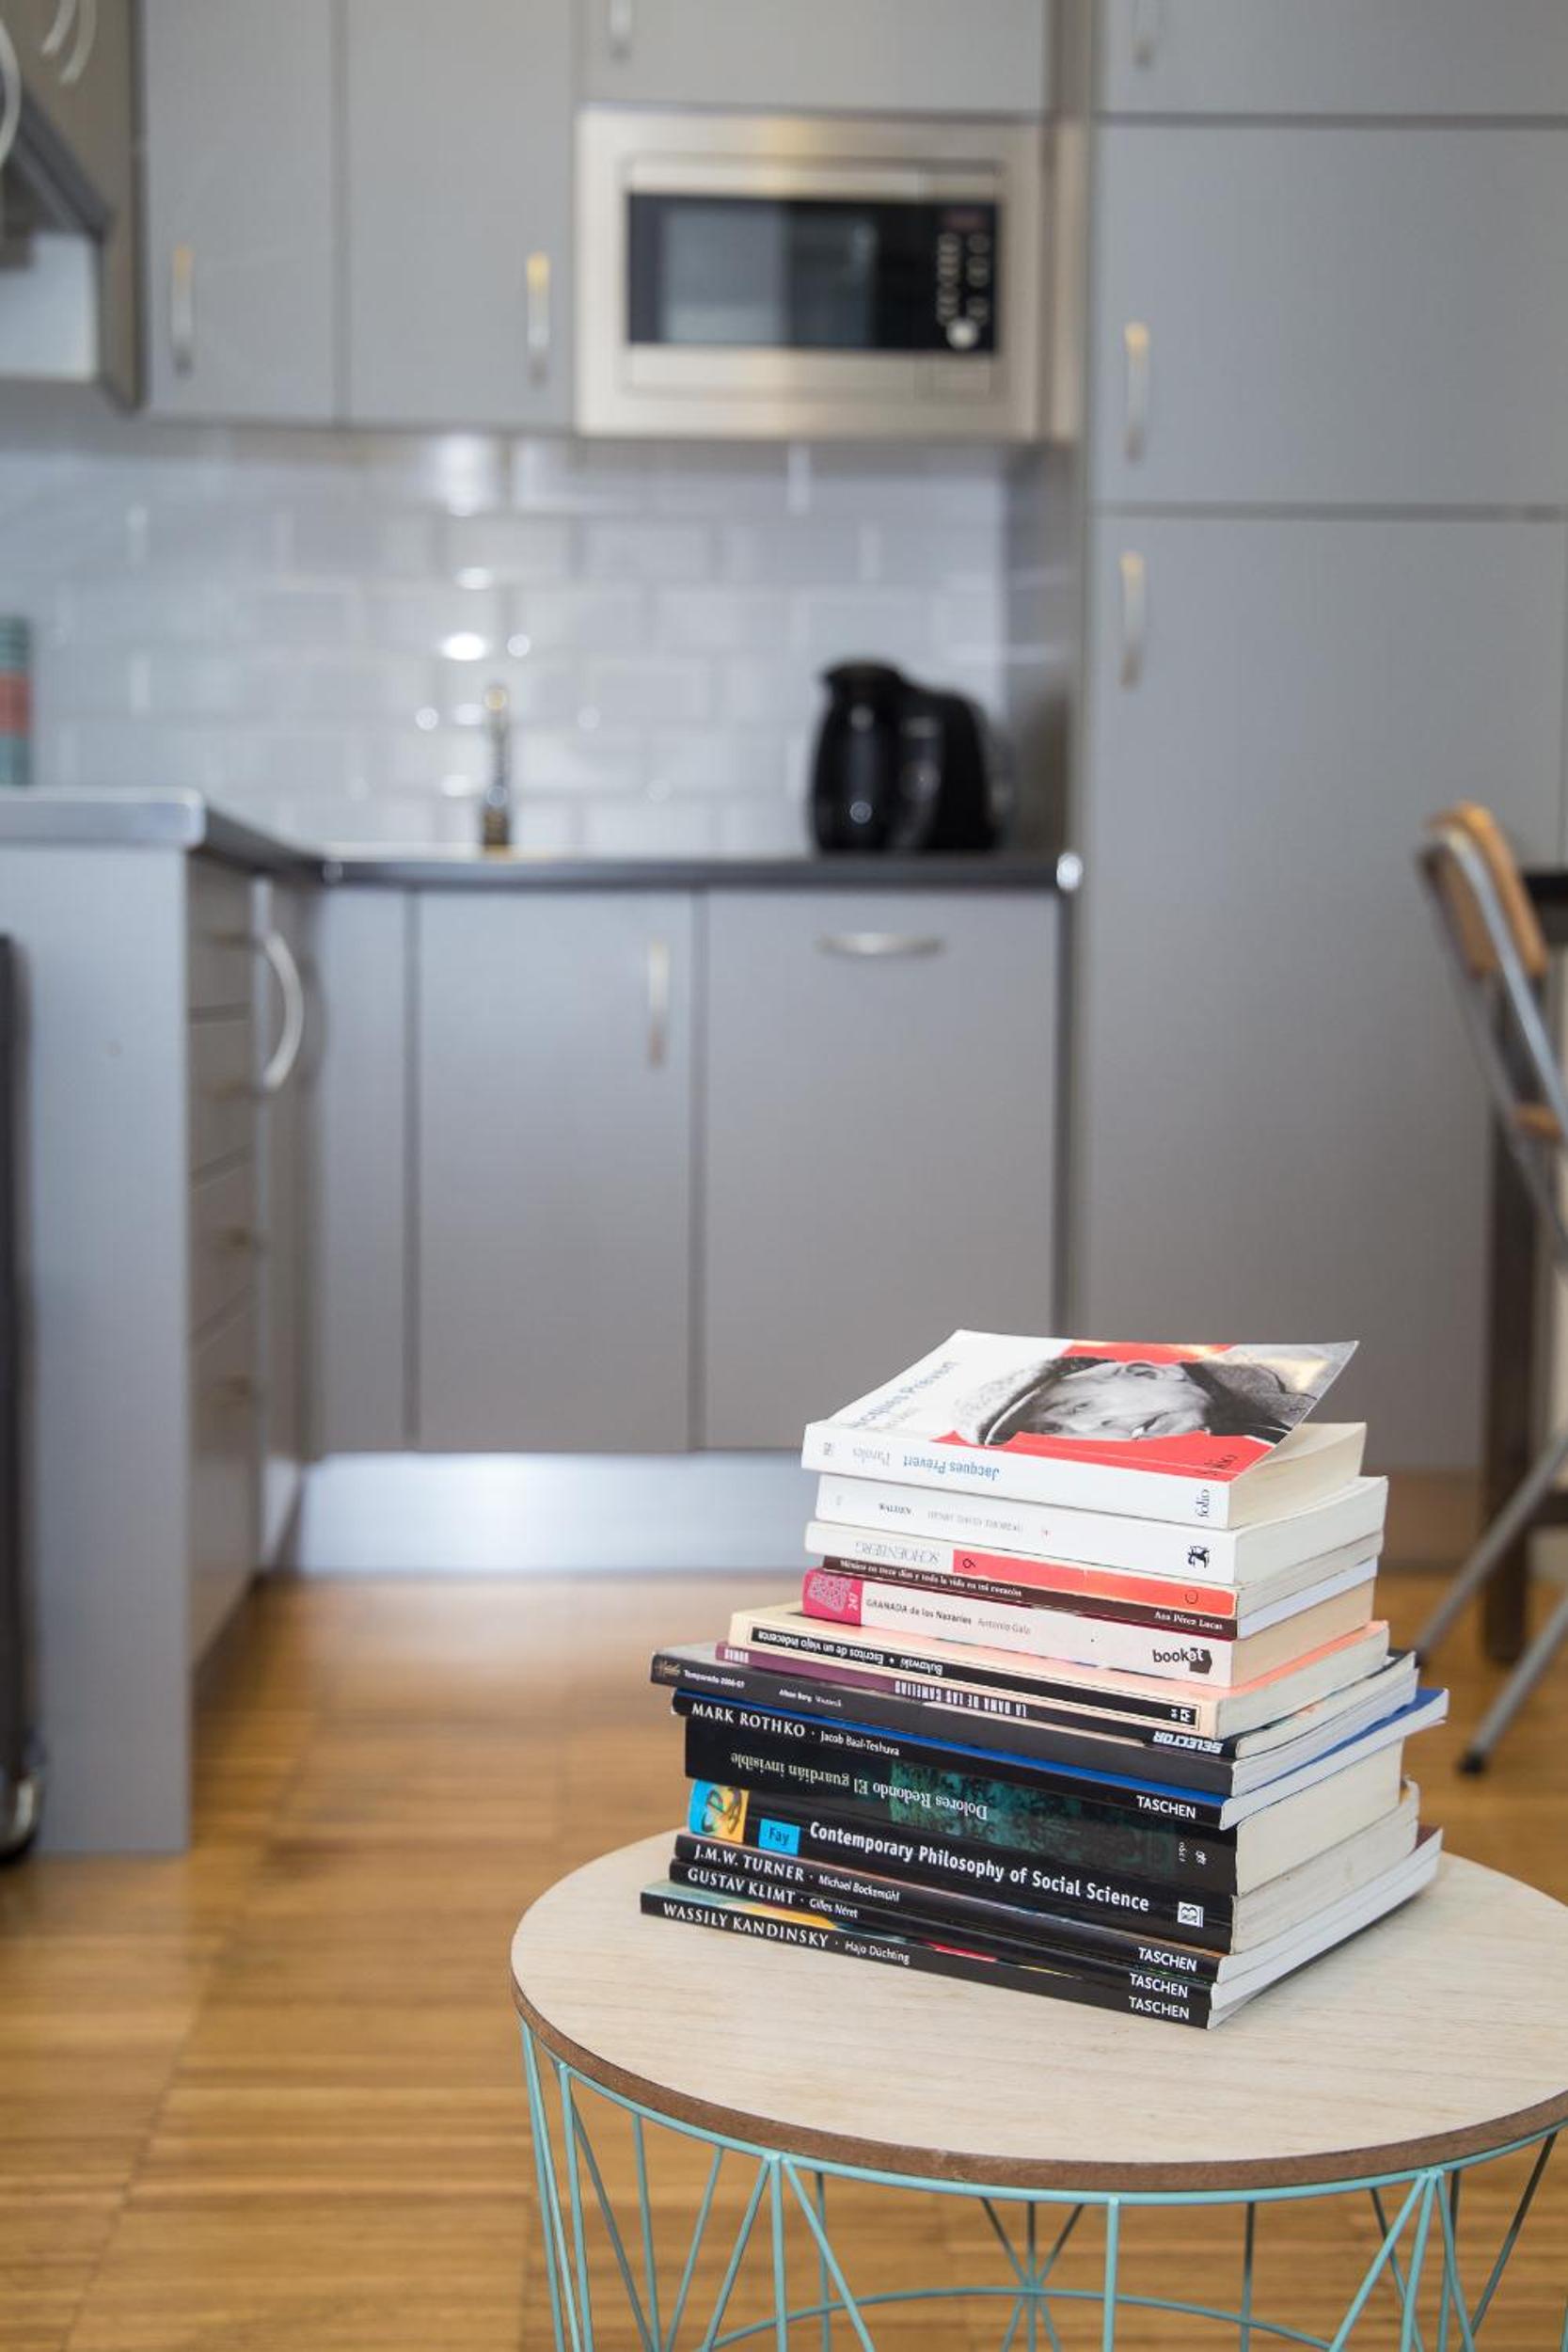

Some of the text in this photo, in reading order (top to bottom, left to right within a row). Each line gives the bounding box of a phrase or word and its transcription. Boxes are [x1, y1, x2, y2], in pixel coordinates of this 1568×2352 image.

[903, 1454, 946, 1474] Prévert
[948, 1460, 999, 1481] Jacques
[1196, 1488, 1210, 1518] folio
[866, 1598, 908, 1614] GRANADA
[910, 1604, 920, 1616] de
[922, 1605, 934, 1618] los
[1153, 1610, 1171, 1622] Ana
[1199, 1617, 1223, 1631] Lucas
[758, 1630, 943, 1675] Bukowski Escritos de un viejo indecente
[684, 1669, 720, 1686] Temporada
[946, 1689, 964, 1706] LAS
[968, 1693, 979, 1709] DE
[984, 1696, 1011, 1715] DAMA
[1015, 1702, 1027, 1719] LA
[692, 1703, 901, 1757] MARK ROTHKO Jacob Baal-Teshuva
[1153, 1731, 1223, 1754] SELECTOR
[730, 1751, 989, 1821] Dolores Redondo El guardián invisible
[1135, 1794, 1196, 1820] TASCHEN
[768, 1826, 791, 1847] Fay
[693, 1843, 738, 1867] J.M.W.
[742, 1854, 805, 1882] TURNER
[817, 1874, 852, 1892] Michael
[810, 1820, 1150, 1912] Contemporary Philosophy of Social Science
[687, 1867, 859, 1919] GUSTAV KLIMT Gilles Néret
[662, 1901, 911, 1966] WASSILY KANDINSKY Hajo Düchting
[1137, 1947, 1197, 1973] TASCHEN
[1129, 1973, 1189, 1999] TASCHEN
[1128, 1994, 1190, 2021] TASCHEN
